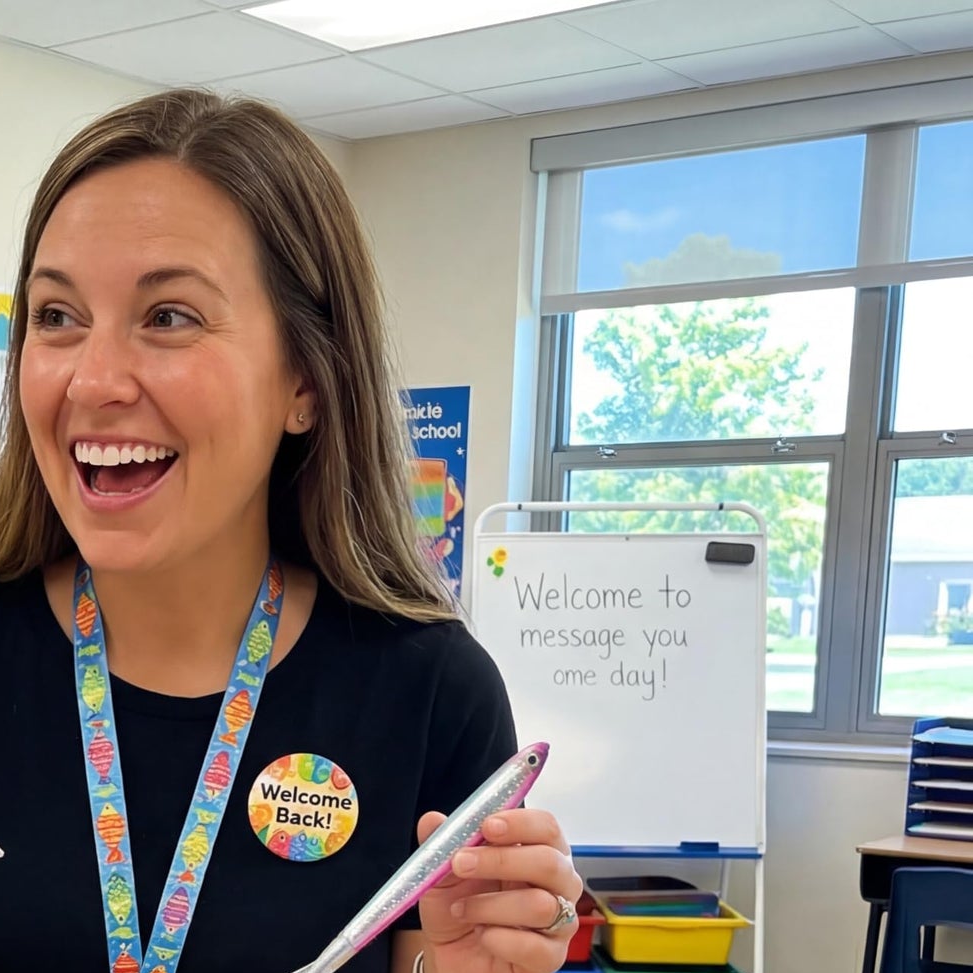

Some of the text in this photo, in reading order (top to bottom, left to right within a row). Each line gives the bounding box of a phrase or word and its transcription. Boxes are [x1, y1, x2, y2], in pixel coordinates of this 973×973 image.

[514, 572, 691, 611] Welcome to
[521, 628, 688, 660] message you
[610, 658, 667, 701] day!
[261, 782, 352, 810] Welcome
[275, 806, 332, 830] Back!
